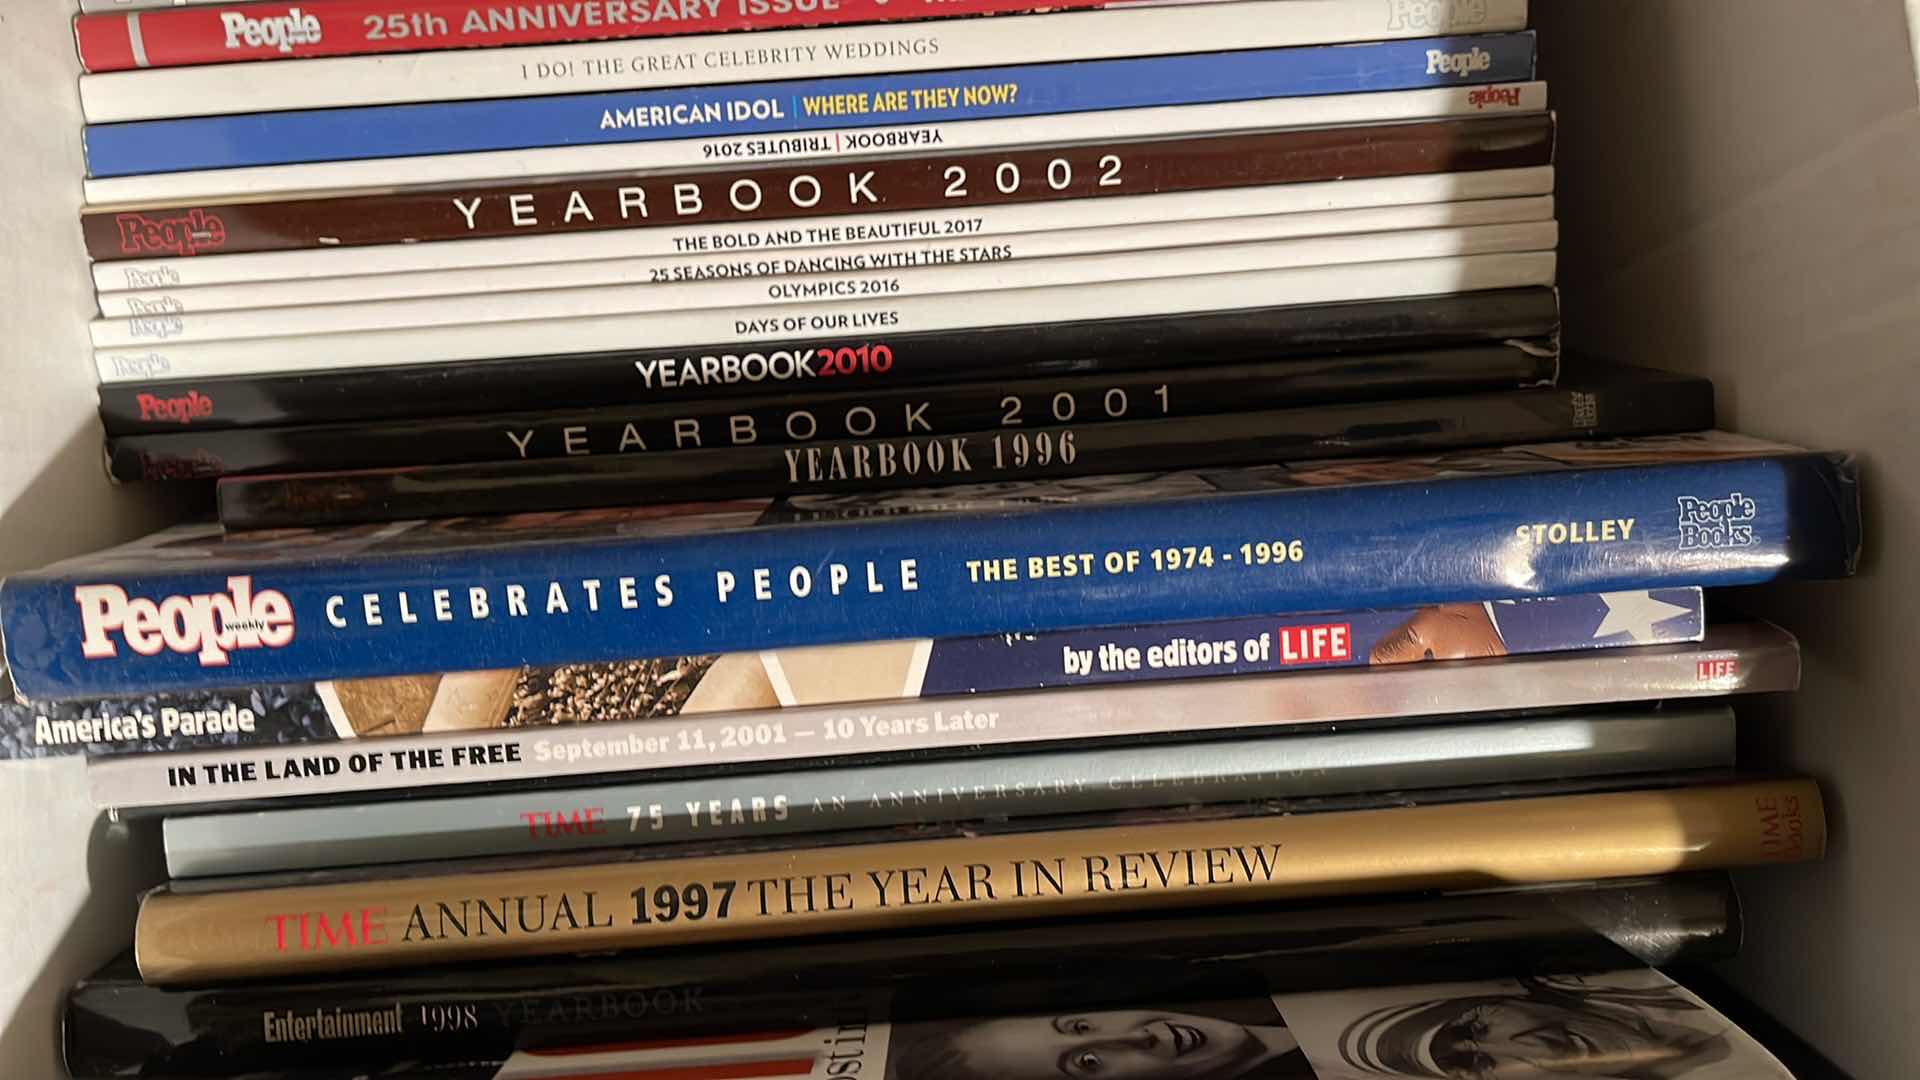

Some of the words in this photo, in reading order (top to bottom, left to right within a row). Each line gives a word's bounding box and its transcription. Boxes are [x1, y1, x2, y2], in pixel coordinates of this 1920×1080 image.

[221, 8, 321, 52] People
[363, 13, 448, 40] 25th
[460, 0, 720, 34] ANNIVERSARY
[521, 64, 528, 80] I
[537, 62, 574, 80] DO!
[583, 58, 625, 76] THE
[630, 52, 698, 73] GREAT
[703, 45, 817, 69] CELEBRITY
[823, 38, 940, 61] WEDDINGS
[1425, 47, 1490, 77] People
[600, 102, 721, 129] AMERICAN
[727, 98, 785, 122] IDOL
[802, 93, 869, 117] WHERE
[873, 91, 909, 113] ARE
[911, 88, 960, 110] THEY
[964, 84, 1018, 107] NOW?
[702, 142, 742, 159] 2016
[748, 137, 831, 156] TRIBUTES
[846, 128, 943, 149] YEARBOOK
[116, 208, 225, 256] People
[452, 171, 878, 230] YEARBOOK
[943, 155, 1123, 198] 2002
[673, 236, 709, 252] THE
[711, 233, 760, 250] BOLD
[765, 230, 803, 247] AND
[806, 228, 841, 244] THE
[844, 221, 941, 241] BEAUTIFUL
[943, 218, 983, 235] 2017
[650, 268, 670, 284] 25
[673, 263, 751, 282] SEASONS
[757, 261, 780, 277] OF
[785, 255, 866, 275] DANCING
[869, 251, 918, 268] WITH
[921, 249, 955, 265] THE
[958, 244, 1013, 263] STARS
[768, 280, 857, 299] OLYMPICS
[860, 278, 900, 294] 2016
[735, 318, 779, 335] DAYS
[783, 317, 808, 332] OF
[811, 315, 848, 330] OUR
[852, 311, 899, 327] LIVES
[135, 389, 214, 423] People
[506, 401, 932, 458] YEARBOOK
[1000, 384, 1168, 424] 2001
[784, 437, 972, 482] YEARBOOK
[991, 430, 1076, 469] 1996
[1678, 493, 1755, 524] People
[1516, 518, 1635, 544] STOLLEY
[966, 558, 1018, 582] THE
[1028, 553, 1095, 579] BEST
[1104, 550, 1141, 574] OF
[1151, 546, 1214, 570] 1974
[1240, 540, 1304, 565] 1996
[325, 574, 674, 628] CELEBRATES
[716, 558, 918, 602] PEOPLE
[75, 576, 294, 666] People
[225, 619, 265, 632] weekly
[1063, 645, 1093, 675] by
[1098, 643, 1141, 671] the
[1147, 638, 1238, 669] editors
[1243, 632, 1271, 662] of
[1281, 626, 1347, 660] LIFE
[1698, 660, 1736, 680] LIFE
[35, 709, 157, 745] America's
[161, 703, 256, 737] Parade
[168, 767, 196, 787] IN
[203, 763, 257, 784] THE
[265, 757, 340, 781] LAND
[348, 753, 383, 773] OF
[390, 749, 445, 770] THE
[451, 744, 522, 766] FREE
[534, 732, 669, 763] September
[677, 732, 715, 755] 11,
[721, 723, 787, 747] 2001
[823, 717, 856, 740] 10
[860, 711, 930, 737] Years
[935, 709, 999, 733] Later
[520, 807, 608, 840] TIME
[626, 804, 664, 832] 75
[685, 794, 789, 827] YEARS
[812, 795, 846, 813] AN
[869, 778, 1086, 809] ANNIVERSARY
[264, 906, 390, 954] TIME
[401, 891, 613, 942] ANNUAL
[630, 880, 737, 925] 1997
[747, 872, 854, 916] THE
[866, 862, 999, 908] YEAR
[1008, 857, 1066, 899] IN
[1080, 843, 1283, 892] REVIEW
[263, 1003, 403, 1043] Entertainment
[420, 1003, 479, 1033] 1998
